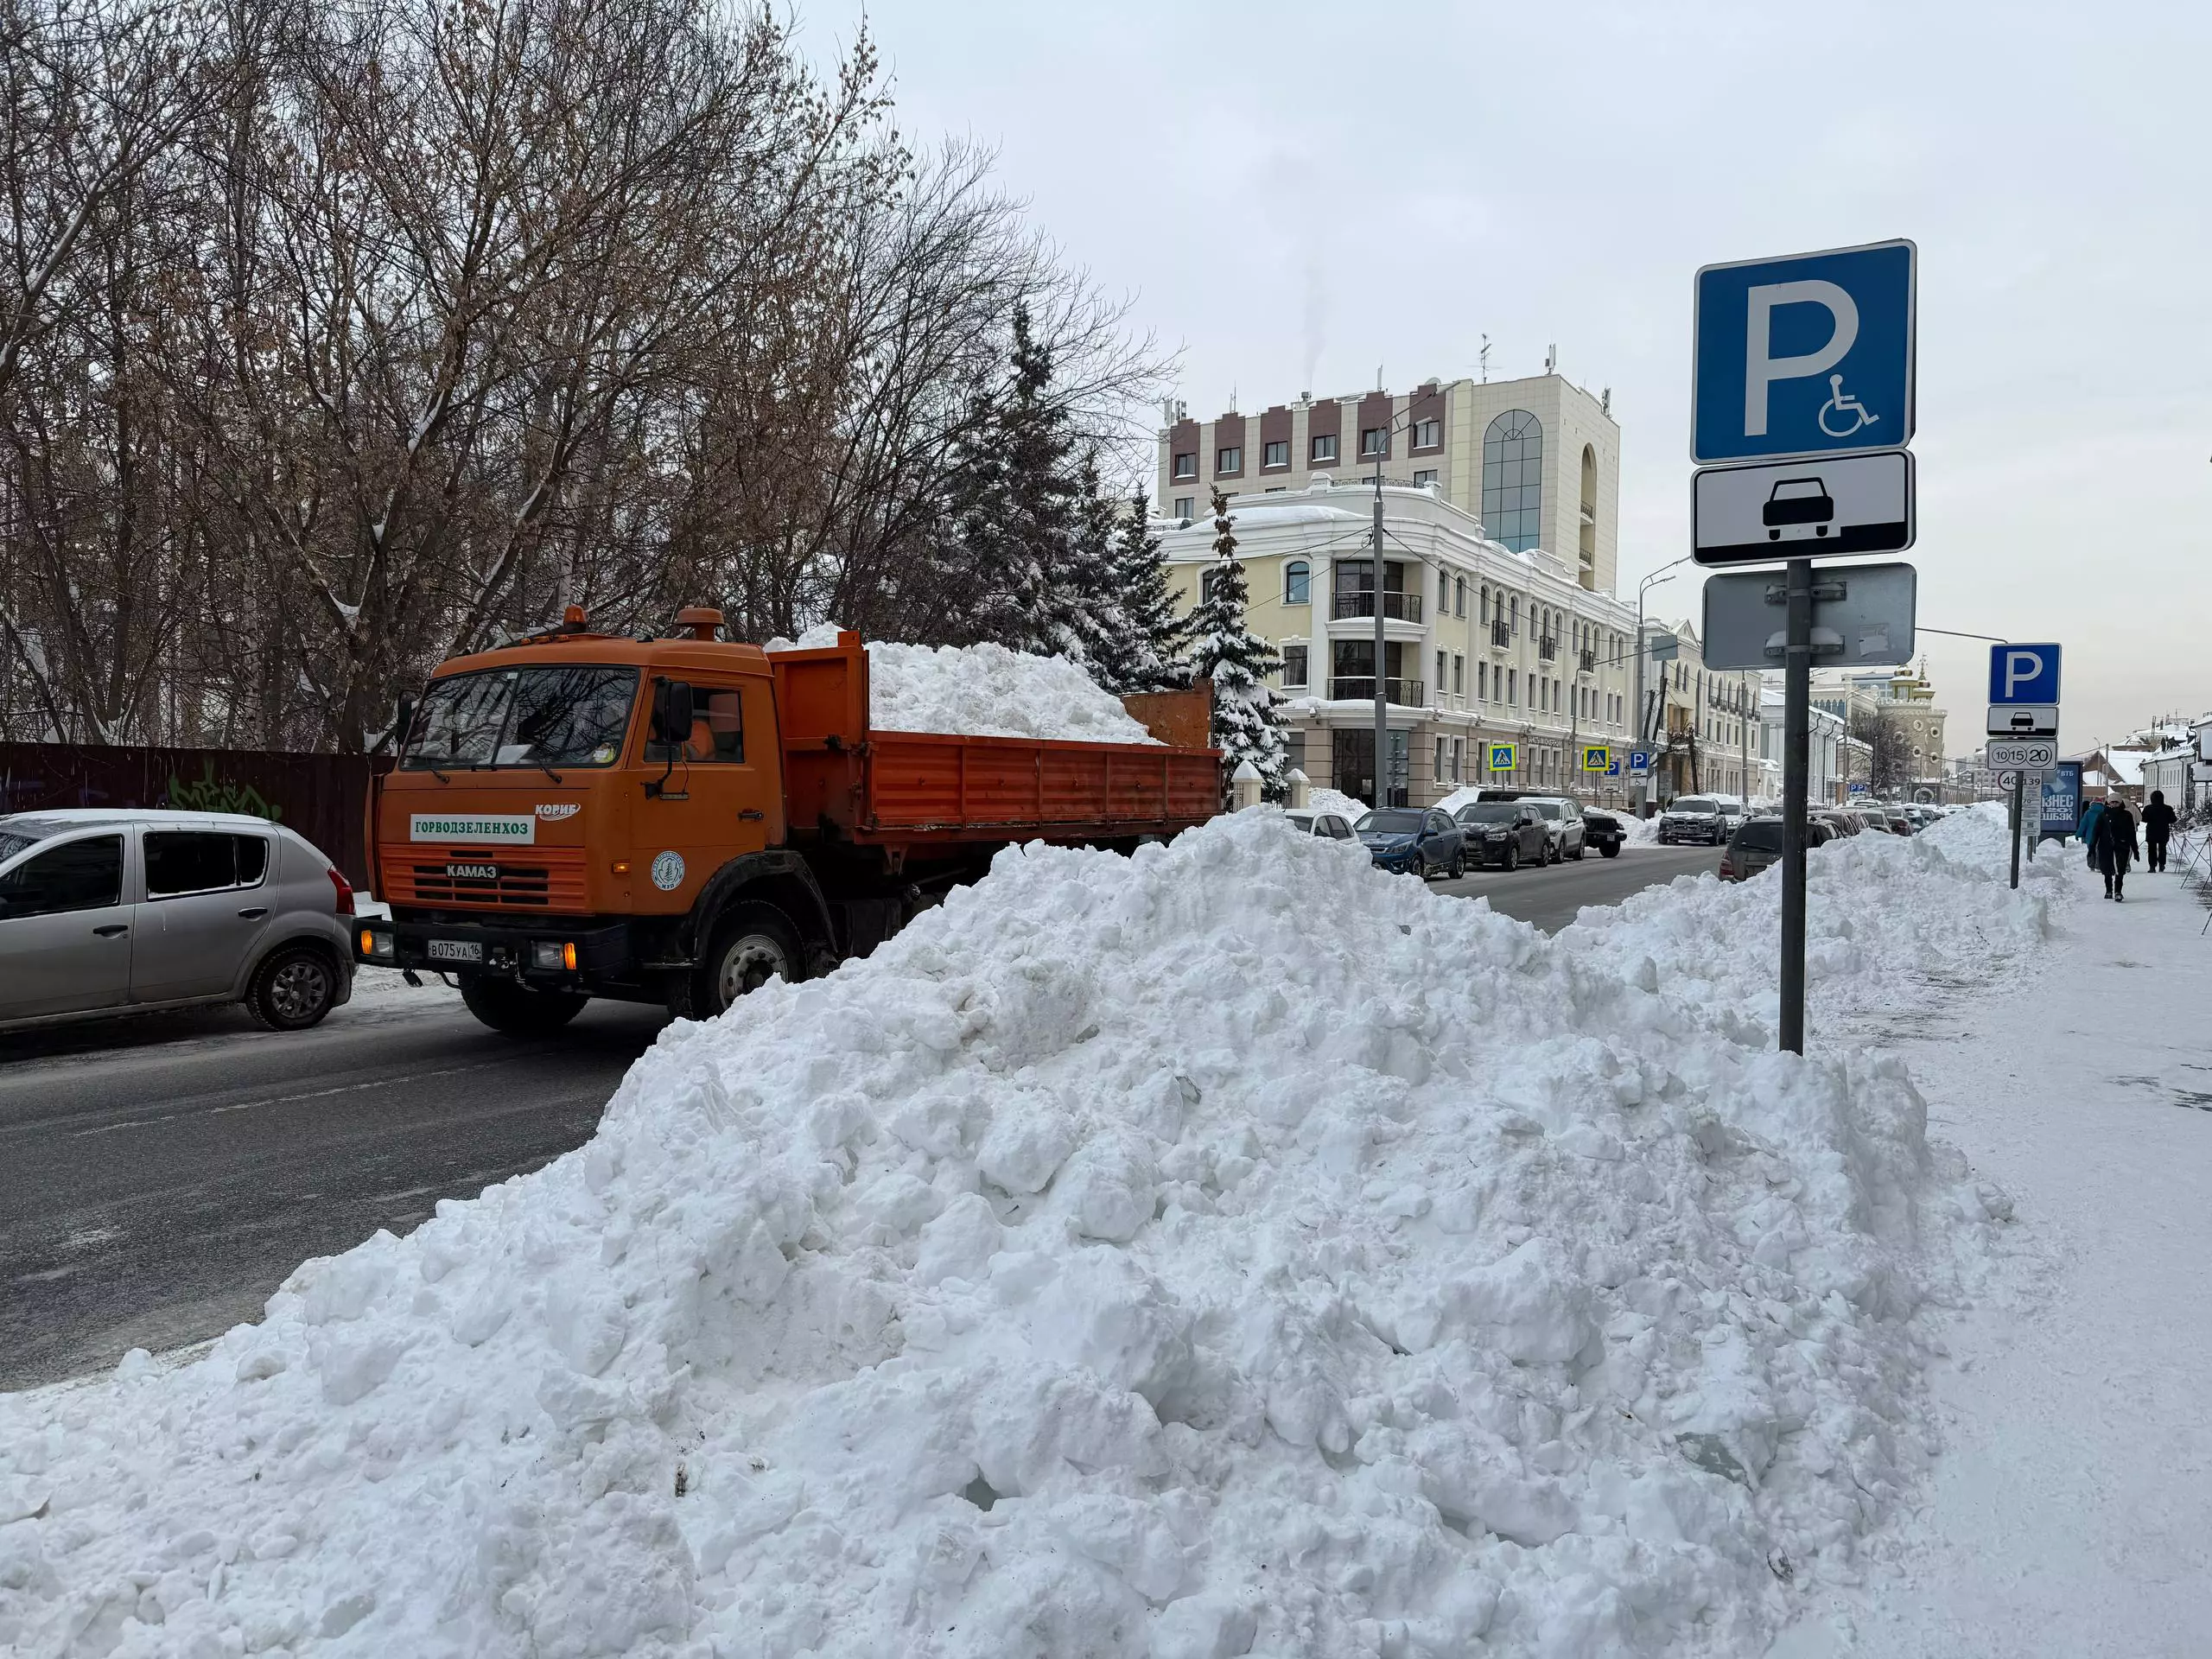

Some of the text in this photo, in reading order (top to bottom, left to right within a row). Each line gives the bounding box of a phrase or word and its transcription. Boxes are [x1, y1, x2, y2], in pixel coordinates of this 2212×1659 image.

[1745, 279, 1859, 436] P
[2005, 651, 2043, 697] P
[1633, 753, 1643, 767] P
[1995, 749, 2049, 761] 10 15 20
[535, 804, 577, 815] КОРИБ
[415, 821, 529, 835] ГОРВОДЗЕЛЕНХОЗ
[446, 864, 497, 878] КАМАЗ
[469, 944, 480, 955] 16
